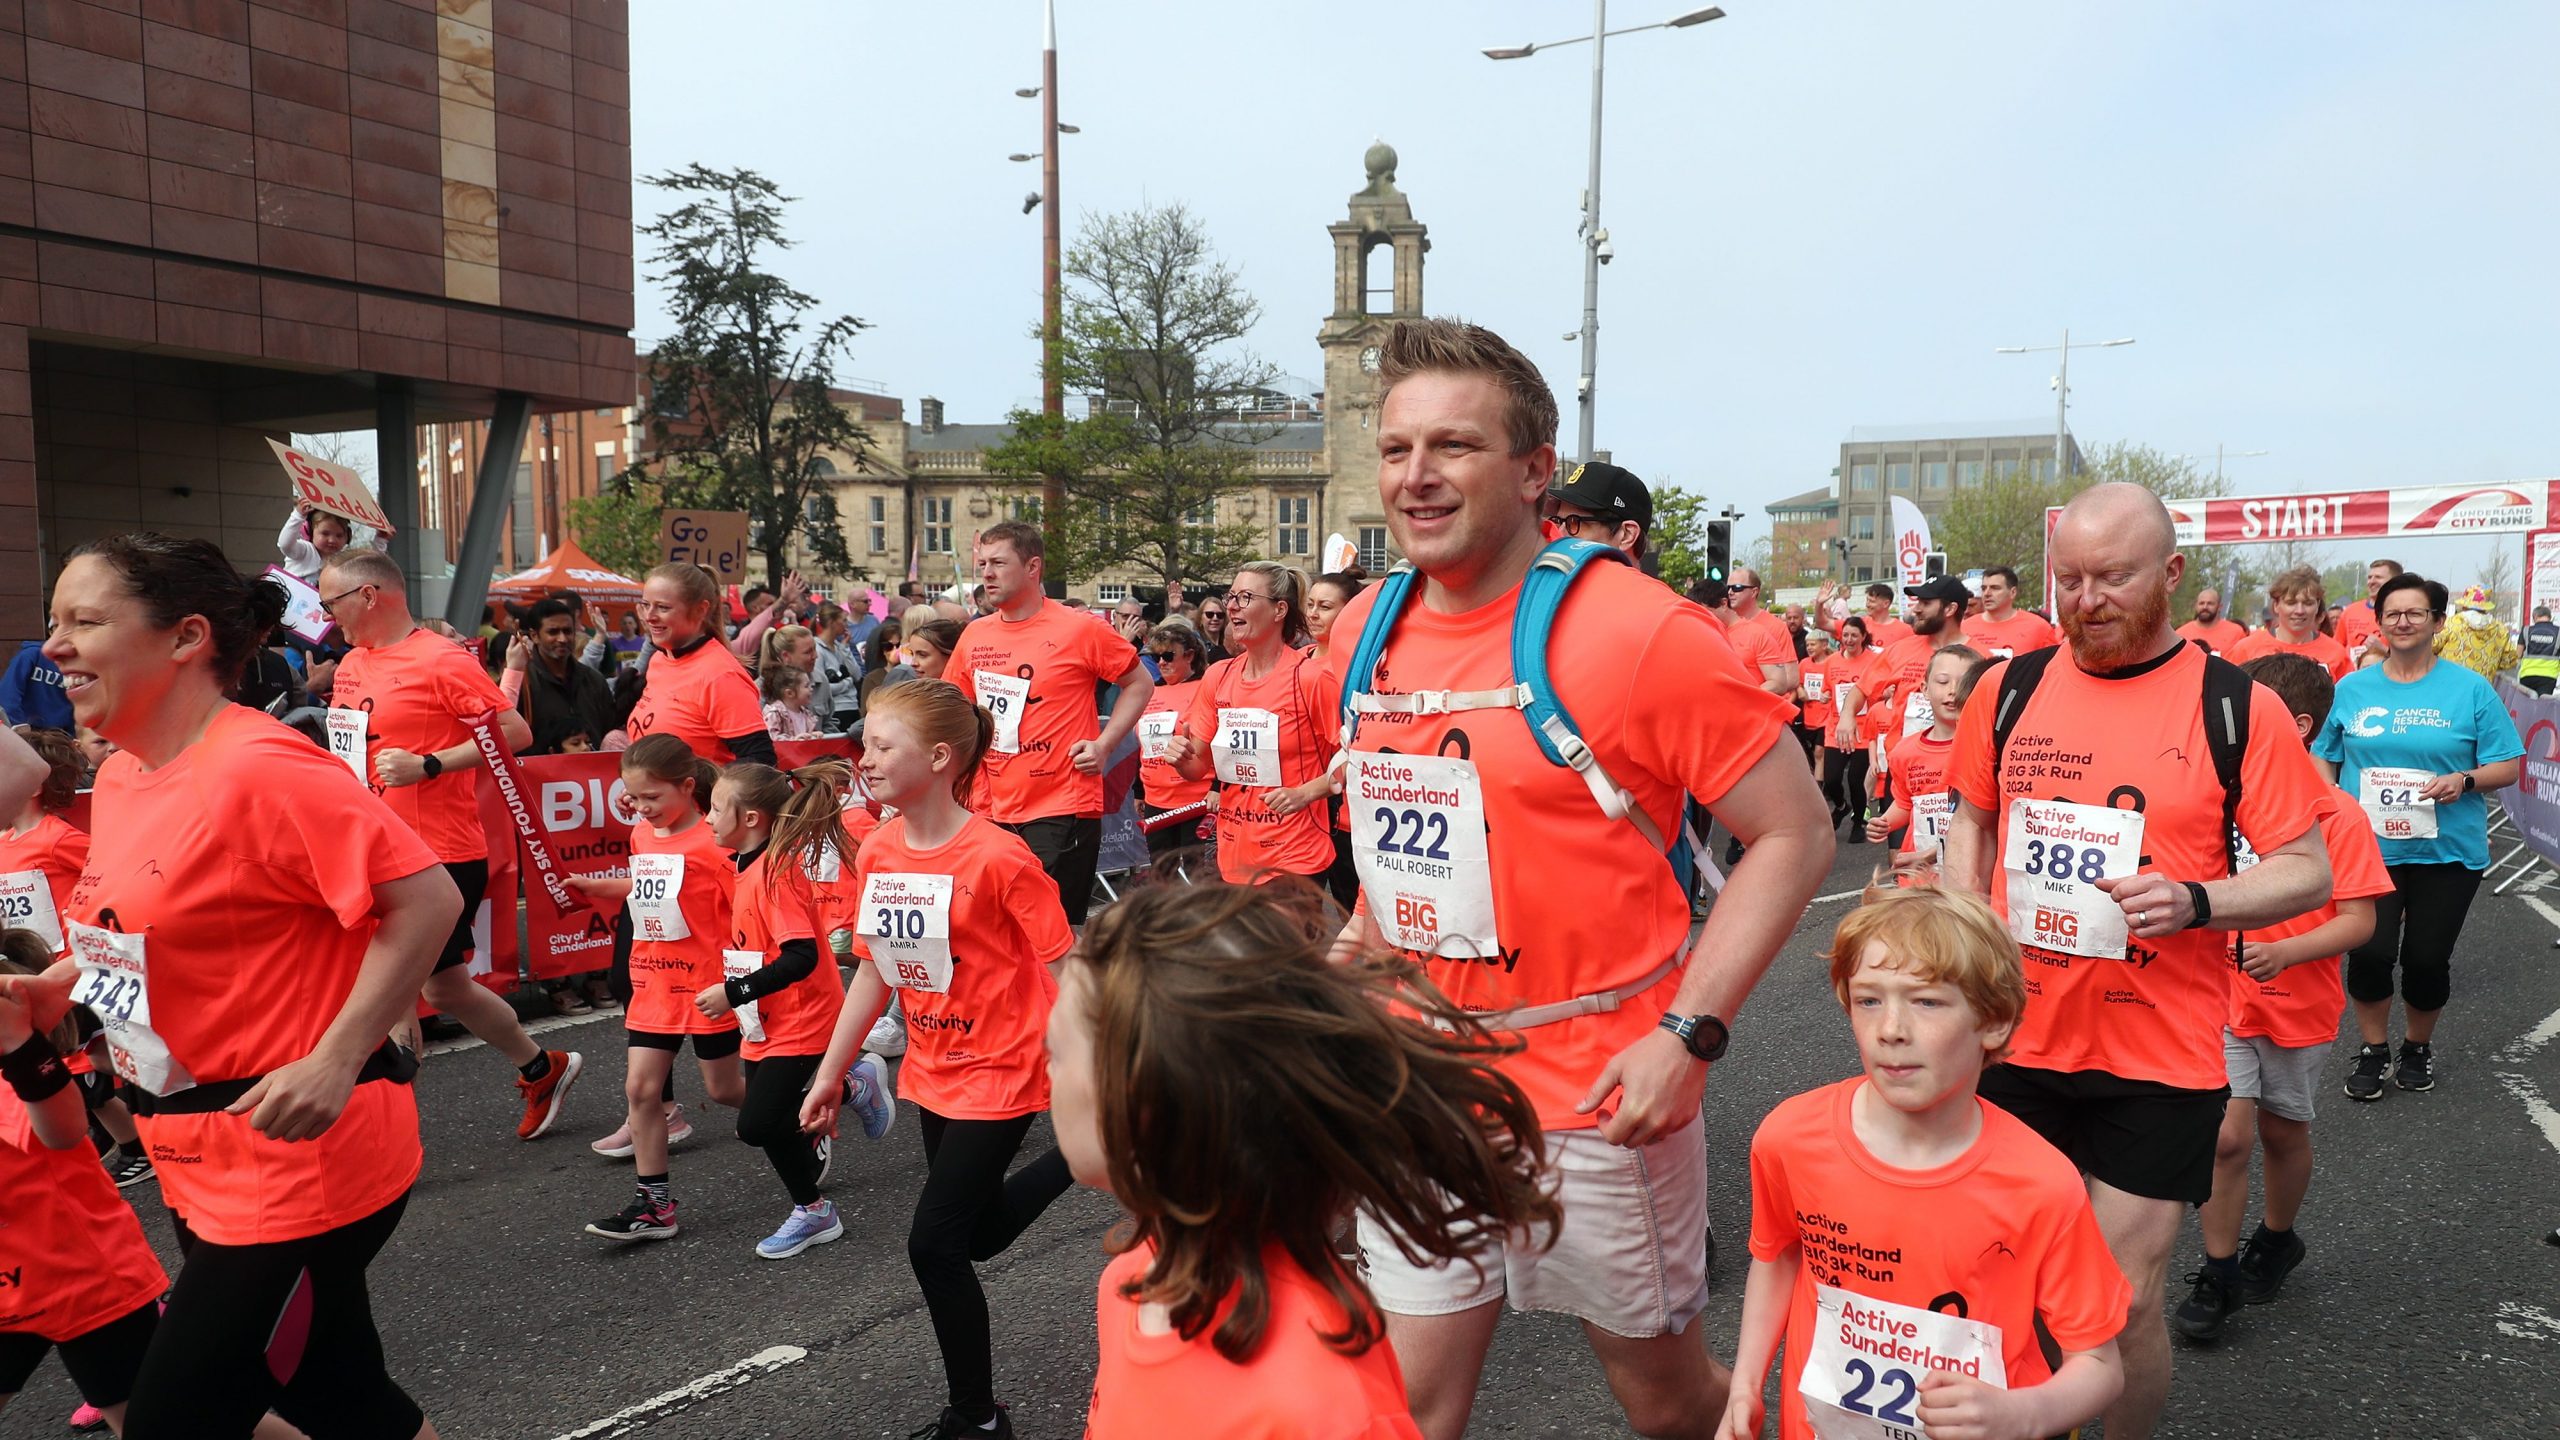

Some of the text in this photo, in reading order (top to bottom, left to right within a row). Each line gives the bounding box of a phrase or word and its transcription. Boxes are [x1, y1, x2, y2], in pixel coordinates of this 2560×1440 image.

[285, 451, 336, 487] Go
[297, 477, 391, 530] Daddy
[2242, 496, 2350, 537] START
[2453, 507, 2533, 518] SUNDERLAND
[671, 516, 708, 543] Go
[2451, 515, 2533, 528] CITY RUNS
[971, 652, 1012, 660] Sunderland
[972, 645, 994, 653] Active
[979, 675, 1002, 686] Active
[1807, 680, 1821, 688] 144
[979, 683, 1021, 698] Sunderland
[986, 694, 1008, 715] 79
[1916, 708, 1934, 721] 22
[2395, 708, 2440, 718] CANCER
[328, 721, 359, 731] Sunderland
[1226, 719, 1268, 729] Sunderland
[2392, 725, 2407, 734] UK
[2393, 717, 2451, 728] RESEARCH
[334, 731, 353, 752] 321
[1230, 730, 1257, 750] 311
[2012, 735, 2053, 747] Active
[2010, 750, 2092, 765] Sunderland
[1235, 765, 1257, 777] BIG
[1361, 761, 1413, 782] Active
[2007, 765, 2082, 781] BIG 3k Run
[2371, 771, 2401, 779] Active
[474, 724, 536, 836] FOUNDATION
[2006, 781, 2033, 793] 2024
[2370, 779, 2425, 788] Sunderland
[1360, 781, 1459, 807] Sunderland
[1920, 798, 1948, 806] Active
[2380, 788, 2412, 806] 64
[1145, 800, 1207, 825] FOUNDATION
[1920, 806, 1949, 814] Sunde
[2025, 806, 2076, 824] Active
[1375, 806, 1450, 861] 222
[1926, 816, 1936, 836] 1
[2025, 820, 2120, 846] Sunderland
[2385, 821, 2411, 831] BIG
[526, 839, 552, 870] SKY
[2025, 839, 2106, 884] 388
[1377, 855, 1453, 880] PAUL ROBERT
[634, 879, 666, 900] 309
[874, 880, 905, 891] Active
[2044, 881, 2074, 895] MIKE
[871, 892, 935, 906] Sunderland
[1395, 890, 1437, 904] Active Sunderland
[1396, 899, 1437, 933] BIG
[2052, 906, 2079, 916] Sunderland
[644, 919, 663, 931] BIG
[877, 908, 925, 939] 310
[2034, 910, 2078, 937] BIG
[549, 929, 585, 945] City of
[550, 935, 612, 955] Sunderland
[890, 940, 918, 950] AMIRA
[1398, 927, 1439, 948] 3K RUN
[2033, 931, 2077, 948] 3K RUN
[896, 962, 929, 980] BIG
[84, 968, 140, 1021] 543
[2104, 989, 2134, 997] Active
[2104, 996, 2156, 1009] Sunderland
[911, 1009, 975, 1034] Activity
[152, 1144, 176, 1154] Active
[153, 1152, 202, 1164] Sunderland
[1797, 1210, 1848, 1235] Active
[1799, 1226, 1901, 1264] Sunderland
[1803, 1244, 1894, 1282] BIG 3k Run
[1841, 1301, 1918, 1338] Active
[1839, 1323, 1980, 1378] Sunderland
[1882, 1424, 1917, 1440] TED
